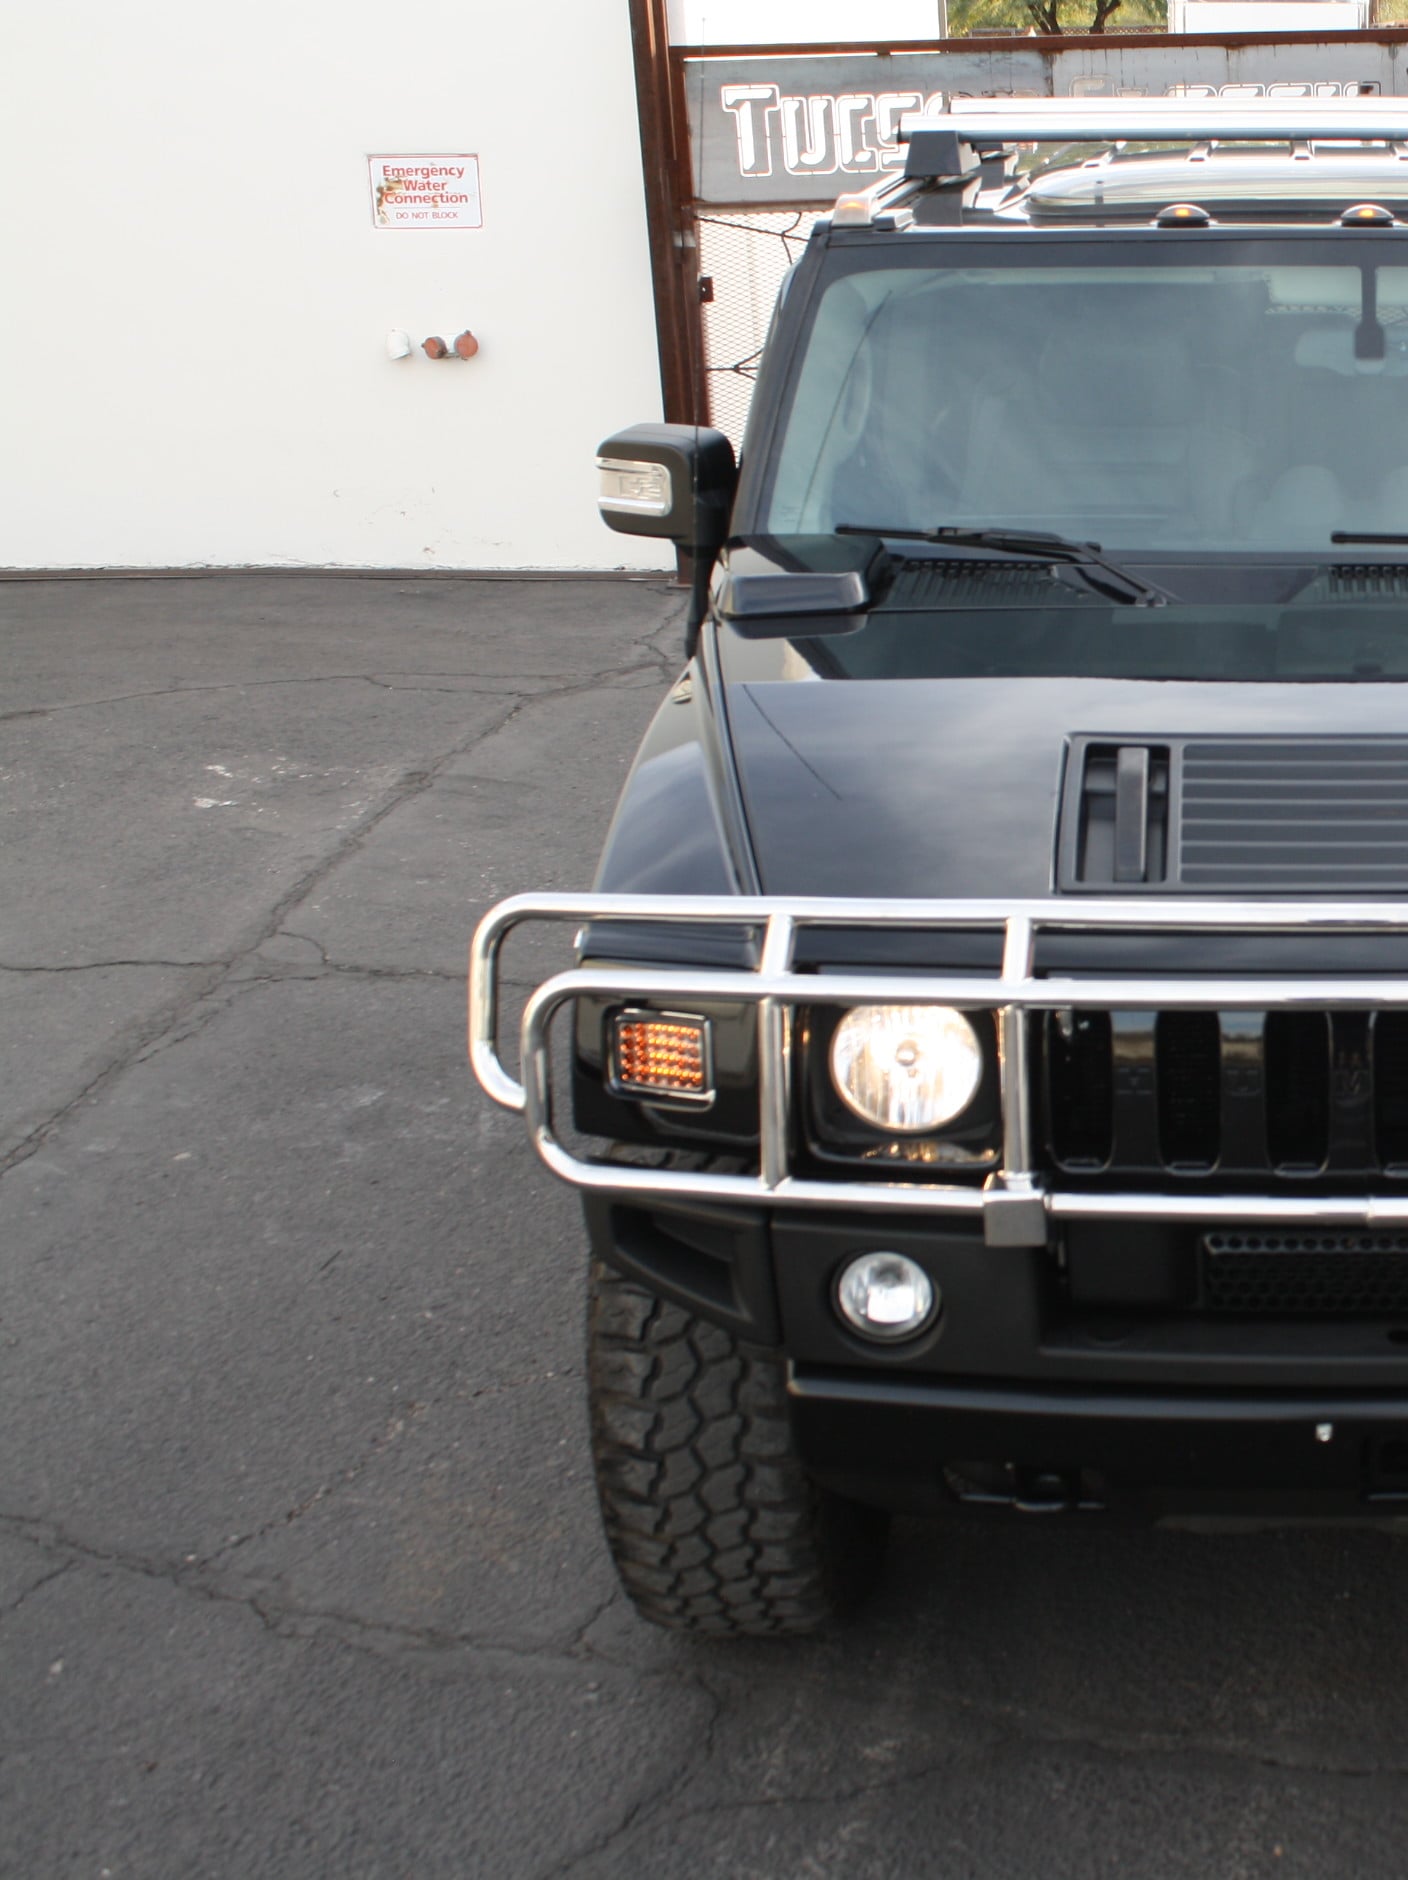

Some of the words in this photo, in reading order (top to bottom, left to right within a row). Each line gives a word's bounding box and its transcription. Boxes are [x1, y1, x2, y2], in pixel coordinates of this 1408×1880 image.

[382, 165, 465, 179] Emergency
[402, 180, 448, 191] Water
[384, 192, 469, 204] Connection
[396, 212, 409, 220] DO
[432, 211, 458, 219] BLOCK
